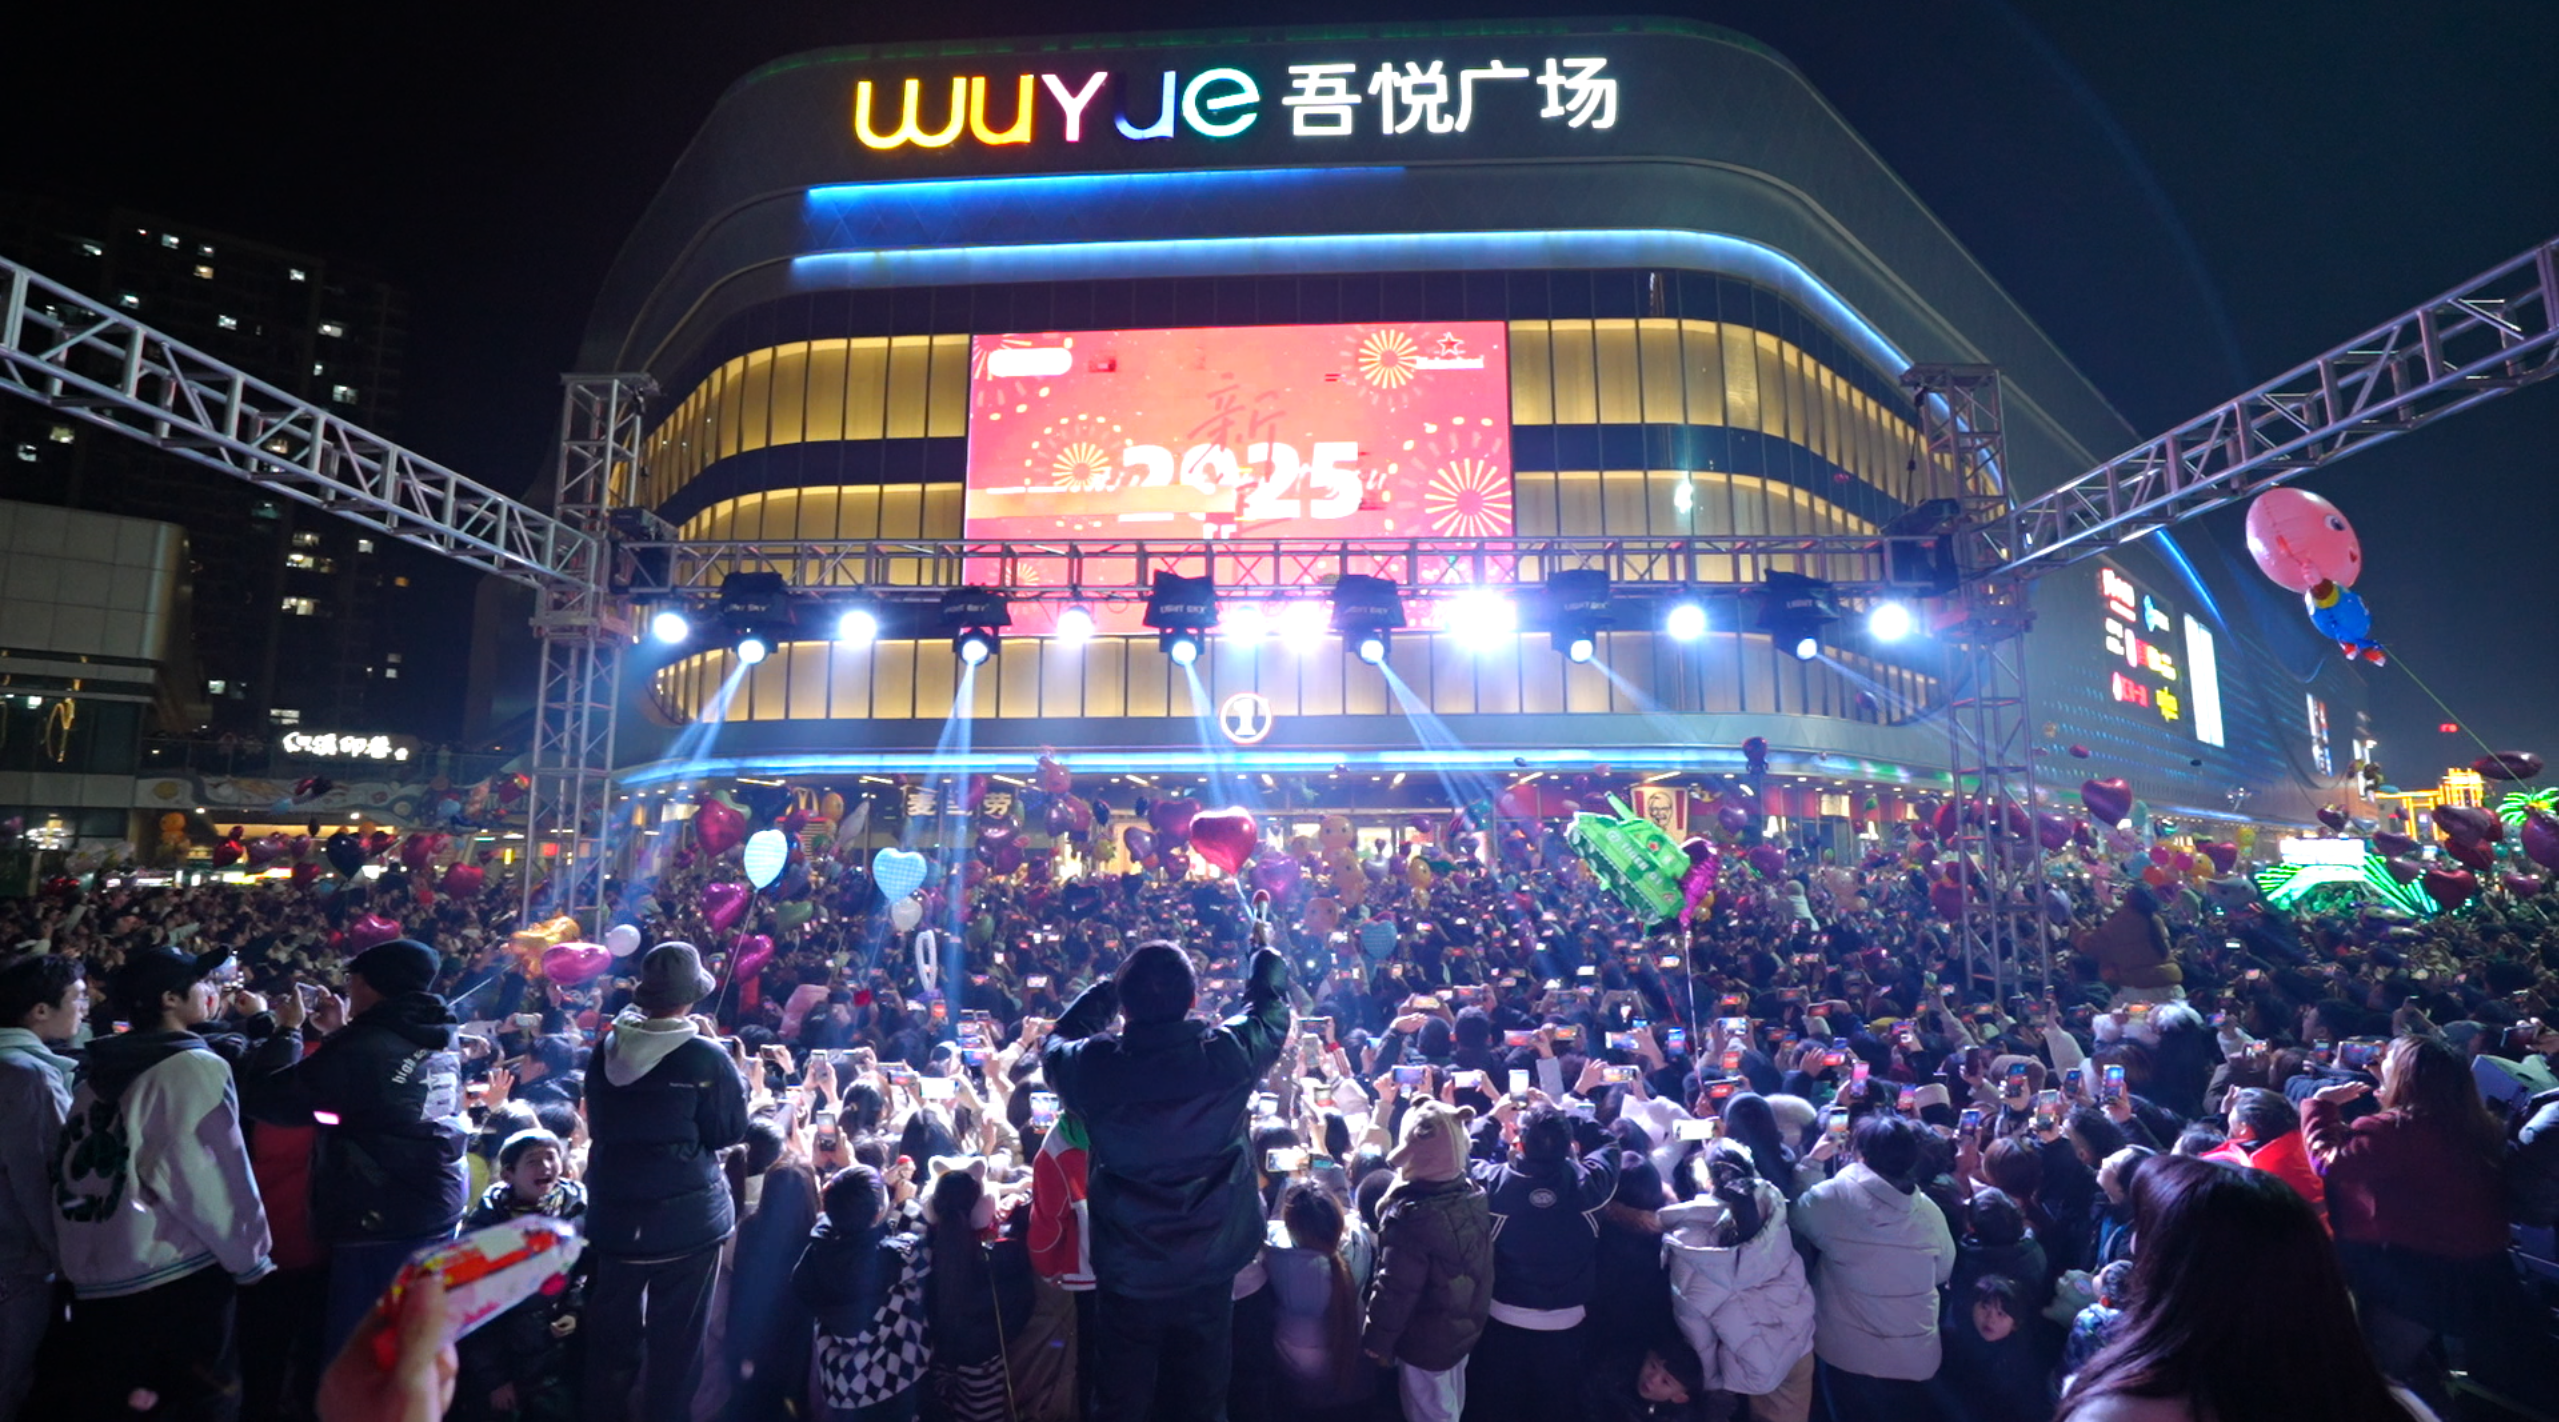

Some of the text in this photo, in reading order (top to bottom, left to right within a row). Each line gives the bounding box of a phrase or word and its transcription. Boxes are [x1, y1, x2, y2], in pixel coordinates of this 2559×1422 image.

[1282, 56, 1619, 138] 吾悦广场
[1119, 441, 1364, 521] 2025
